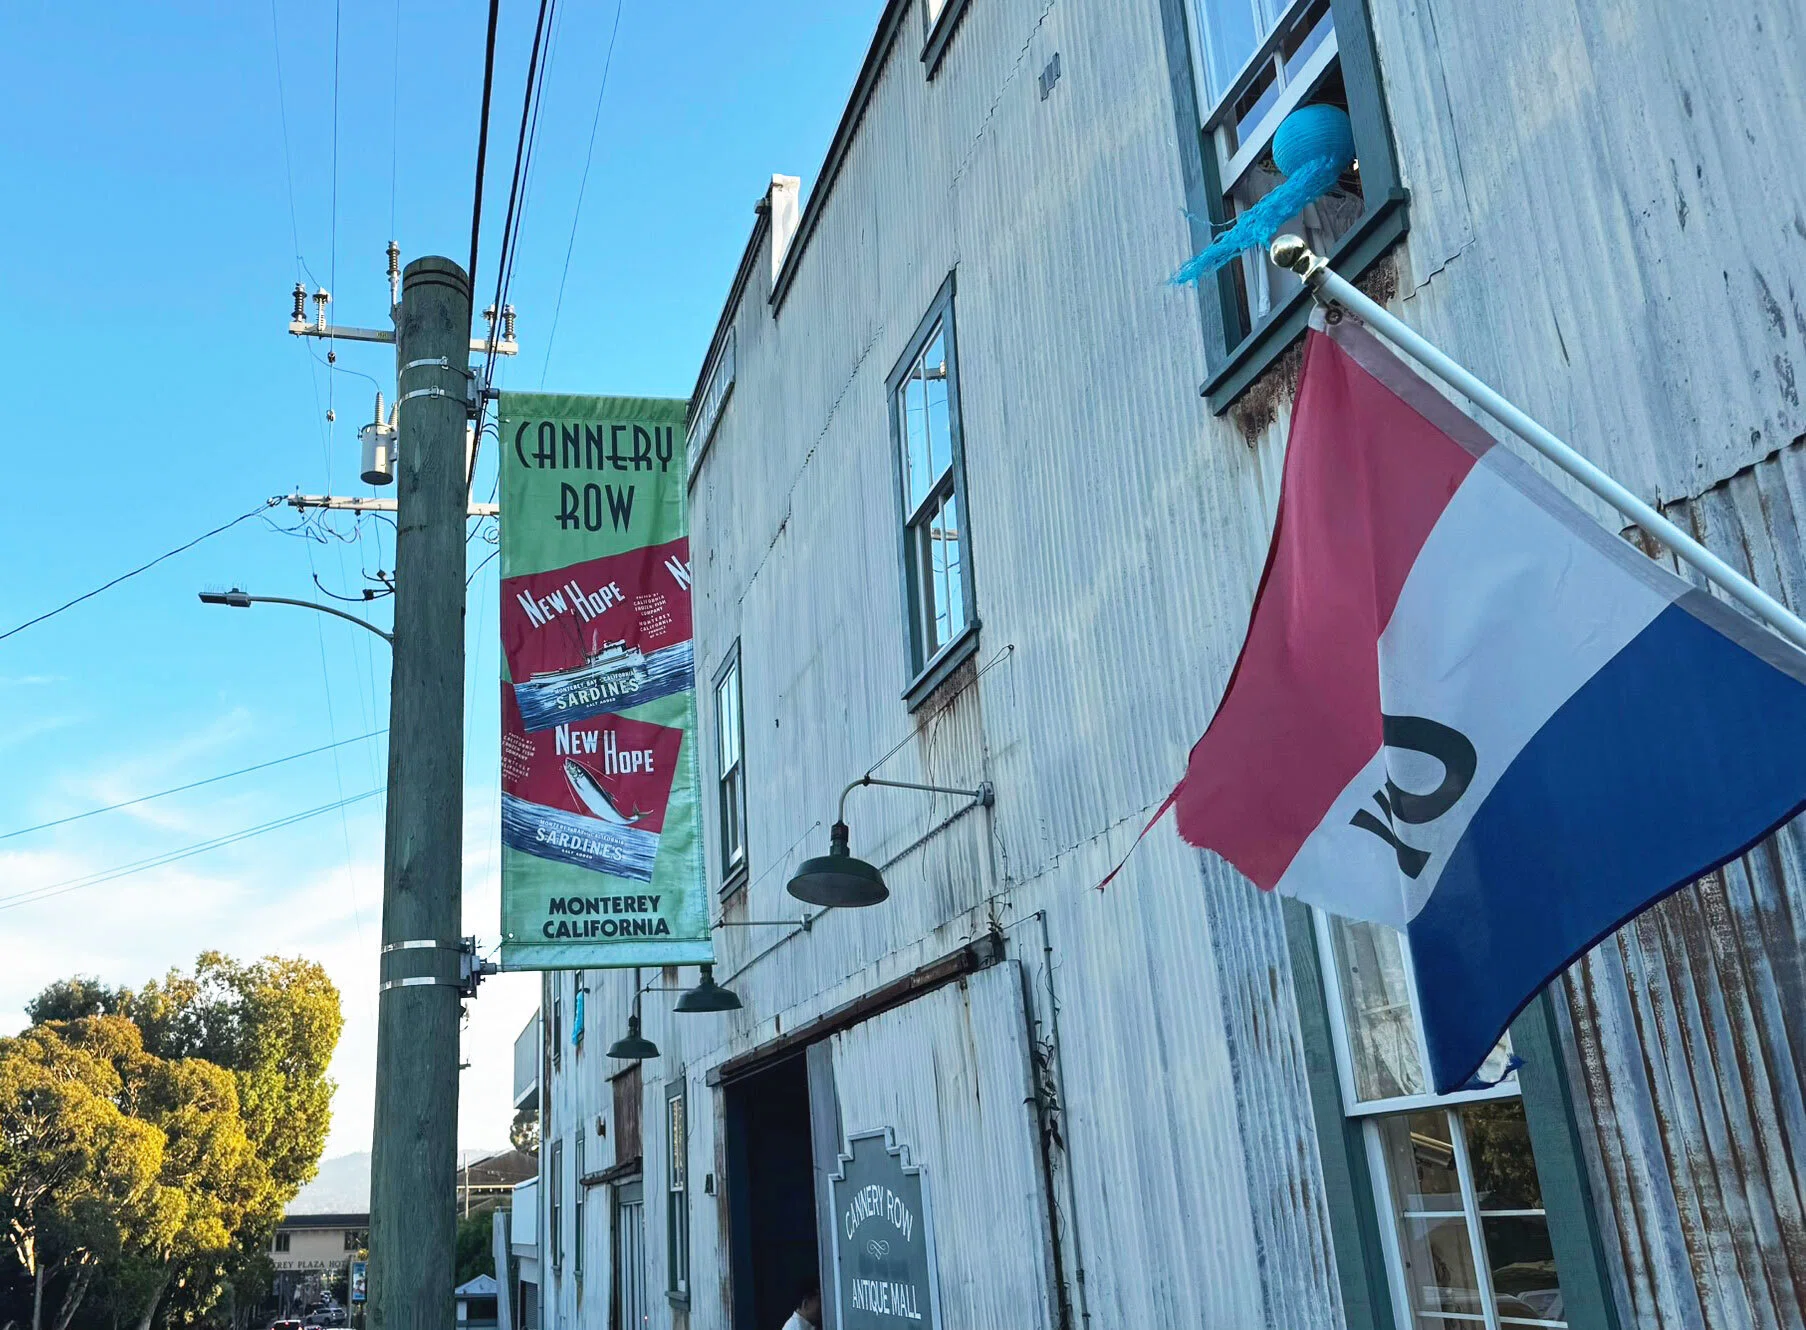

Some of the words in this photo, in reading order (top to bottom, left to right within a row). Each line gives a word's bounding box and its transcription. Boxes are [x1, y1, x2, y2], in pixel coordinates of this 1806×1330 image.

[514, 421, 674, 472] CANNERY
[554, 482, 635, 534] ROW
[516, 589, 568, 628] NEW
[564, 579, 626, 623] HOPE
[556, 678, 640, 710] SARDINES
[555, 723, 599, 755] NEW
[603, 730, 654, 775] HOPE
[535, 827, 624, 861] SARDINES
[548, 895, 661, 915] MONTEREY
[542, 918, 671, 939] CALIFORNIA
[845, 1184, 885, 1241] CANNERY
[886, 1188, 914, 1243] ROW
[298, 1260, 325, 1269] PLAZA
[852, 1278, 890, 1316] ANTIQUE
[890, 1282, 922, 1320] MALL
